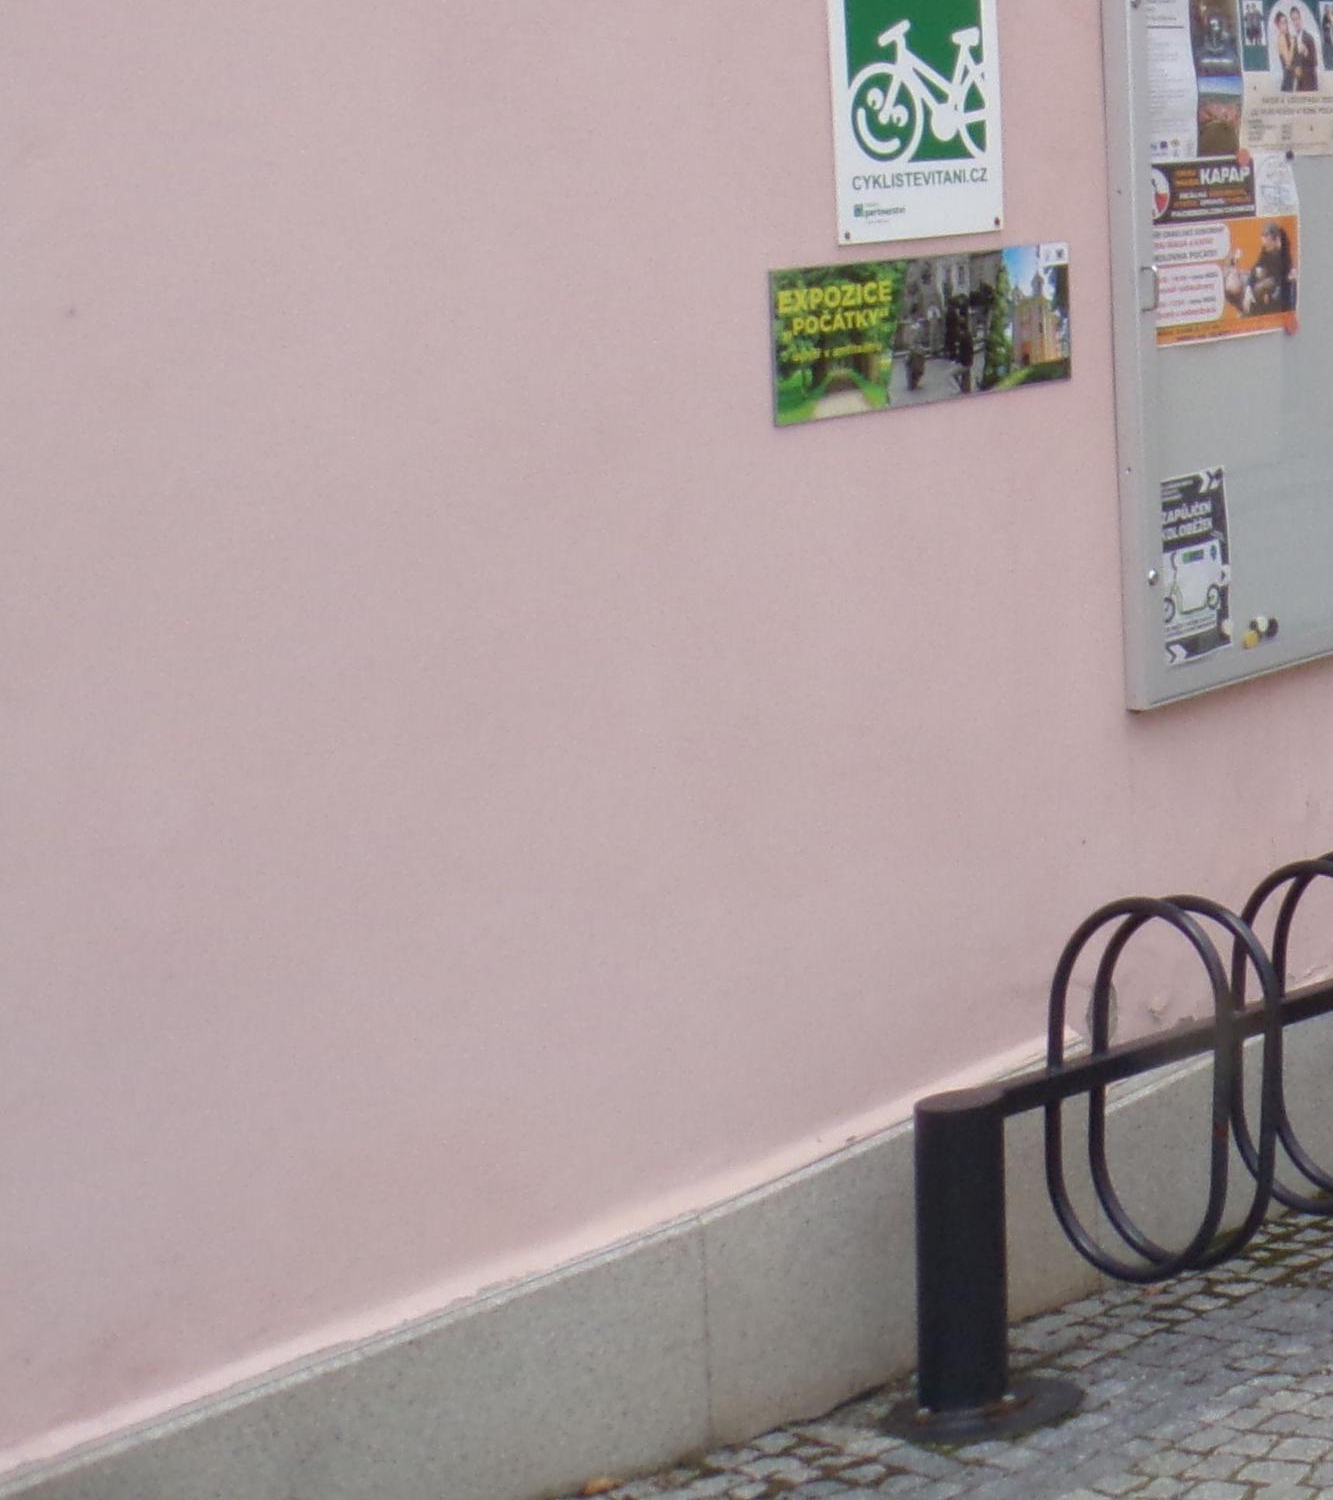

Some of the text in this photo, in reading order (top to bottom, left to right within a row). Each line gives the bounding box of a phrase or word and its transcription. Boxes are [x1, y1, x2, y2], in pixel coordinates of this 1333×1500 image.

[852, 167, 989, 191] CYKLISTEVITANI.CZ
[1200, 166, 1251, 185] KAPAP
[778, 279, 893, 314] EXPOZICE
